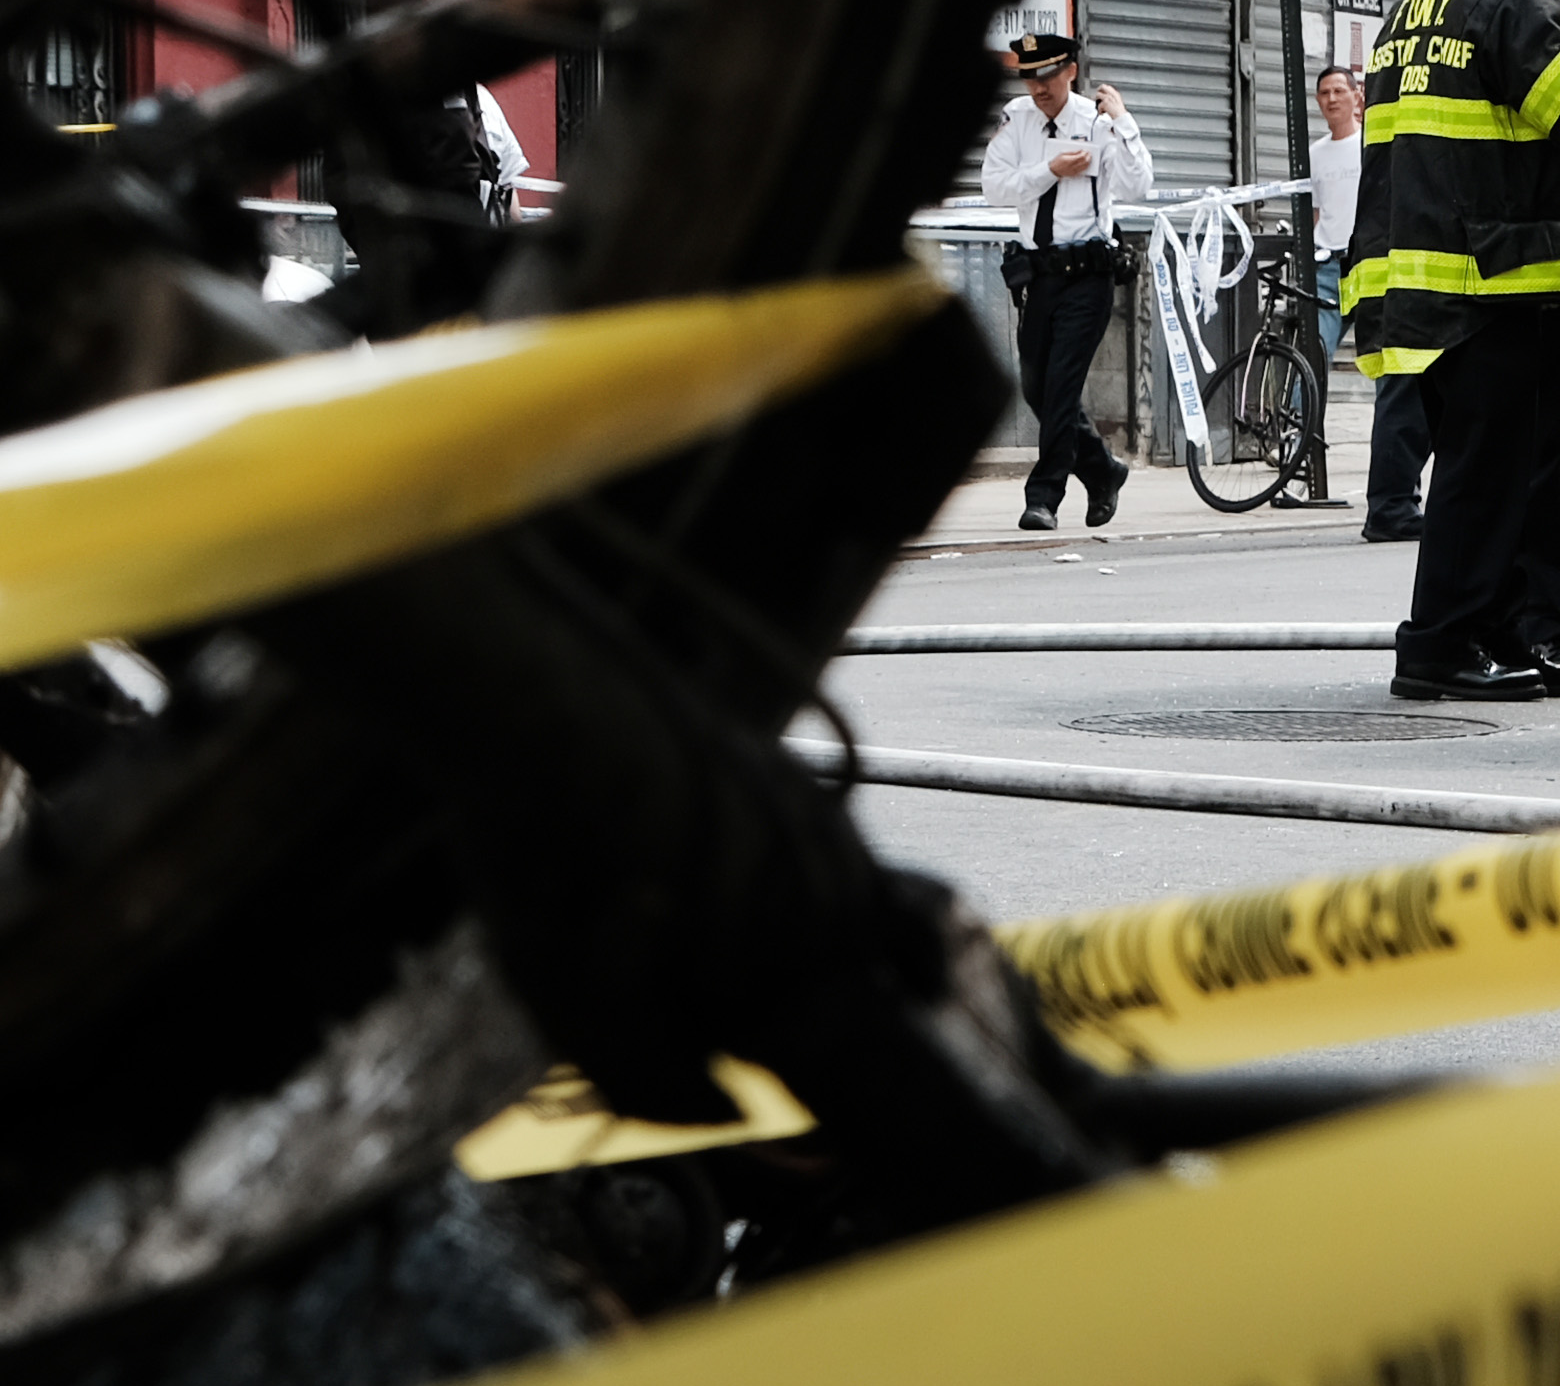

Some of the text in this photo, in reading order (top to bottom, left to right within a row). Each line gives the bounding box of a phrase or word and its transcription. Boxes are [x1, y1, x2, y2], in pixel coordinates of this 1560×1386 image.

[1426, 35, 1475, 69] CHIEF
[1160, 290, 1173, 313] NOT
[1166, 316, 1178, 332] DO
[1172, 351, 1189, 373] LINE
[1180, 380, 1200, 416] POLICE
